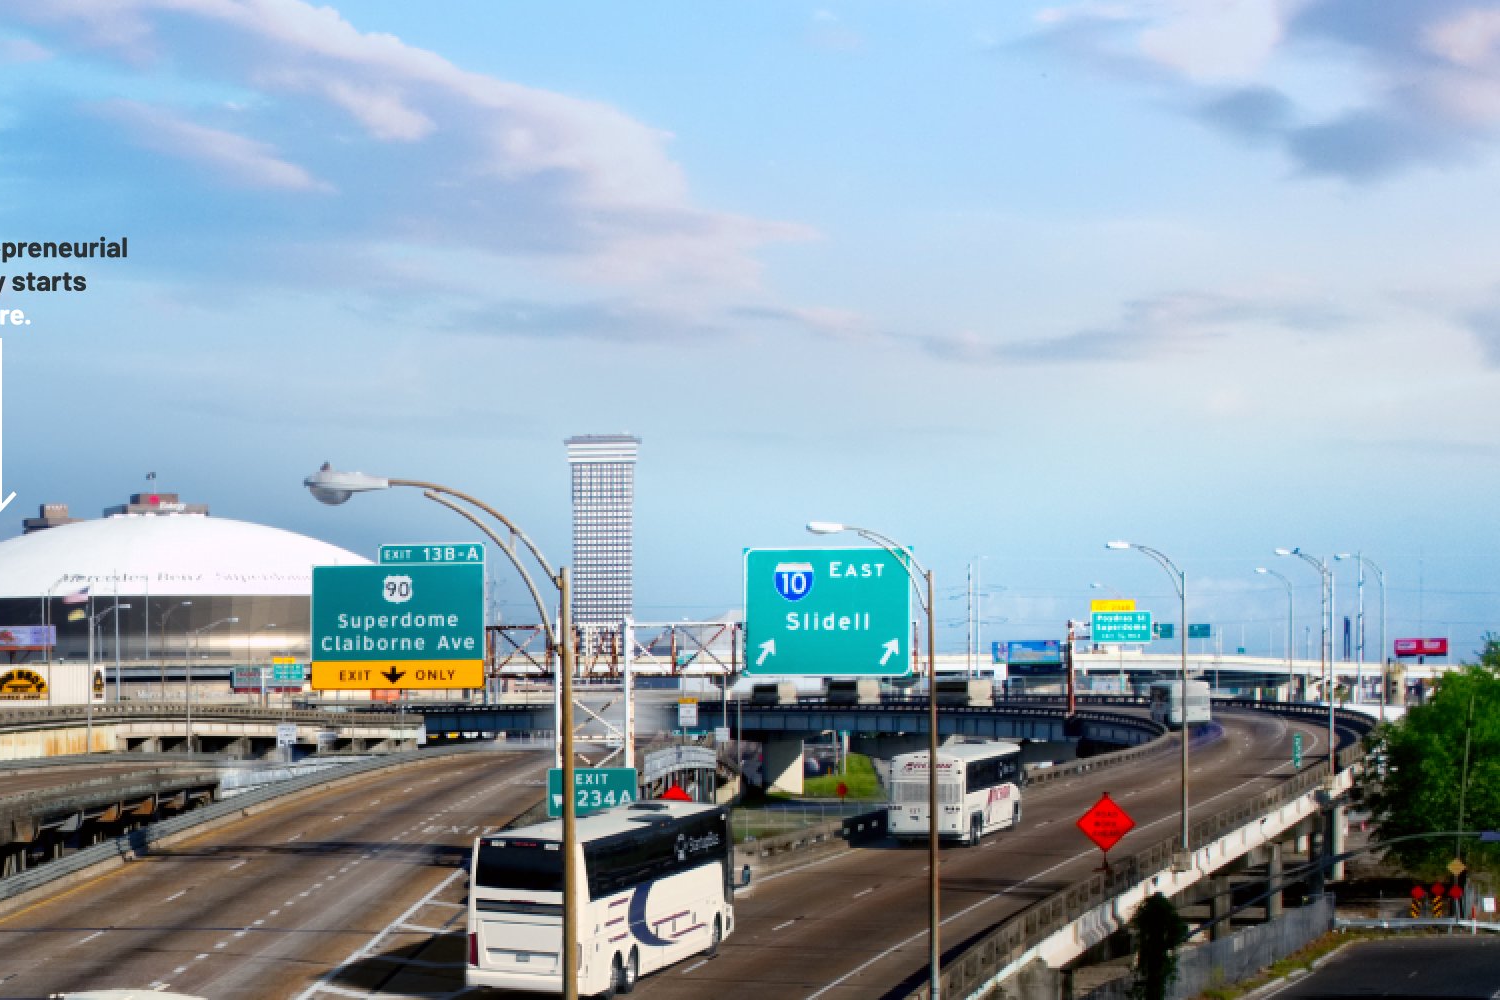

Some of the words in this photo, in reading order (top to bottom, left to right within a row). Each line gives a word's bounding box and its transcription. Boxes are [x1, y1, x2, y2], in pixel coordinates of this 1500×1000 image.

[383, 549, 413, 561] EXIT
[423, 547, 479, 561] 13B-A
[385, 581, 410, 597] 90
[781, 573, 808, 595] 10
[337, 612, 460, 632] Superdome
[785, 612, 870, 631] Slidell
[321, 635, 426, 651] Claiborne
[437, 635, 475, 650] Ave
[339, 669, 372, 681] EXIT
[415, 669, 456, 681] ONLY
[575, 773, 609, 785] EXIT
[577, 789, 633, 807] 234A
